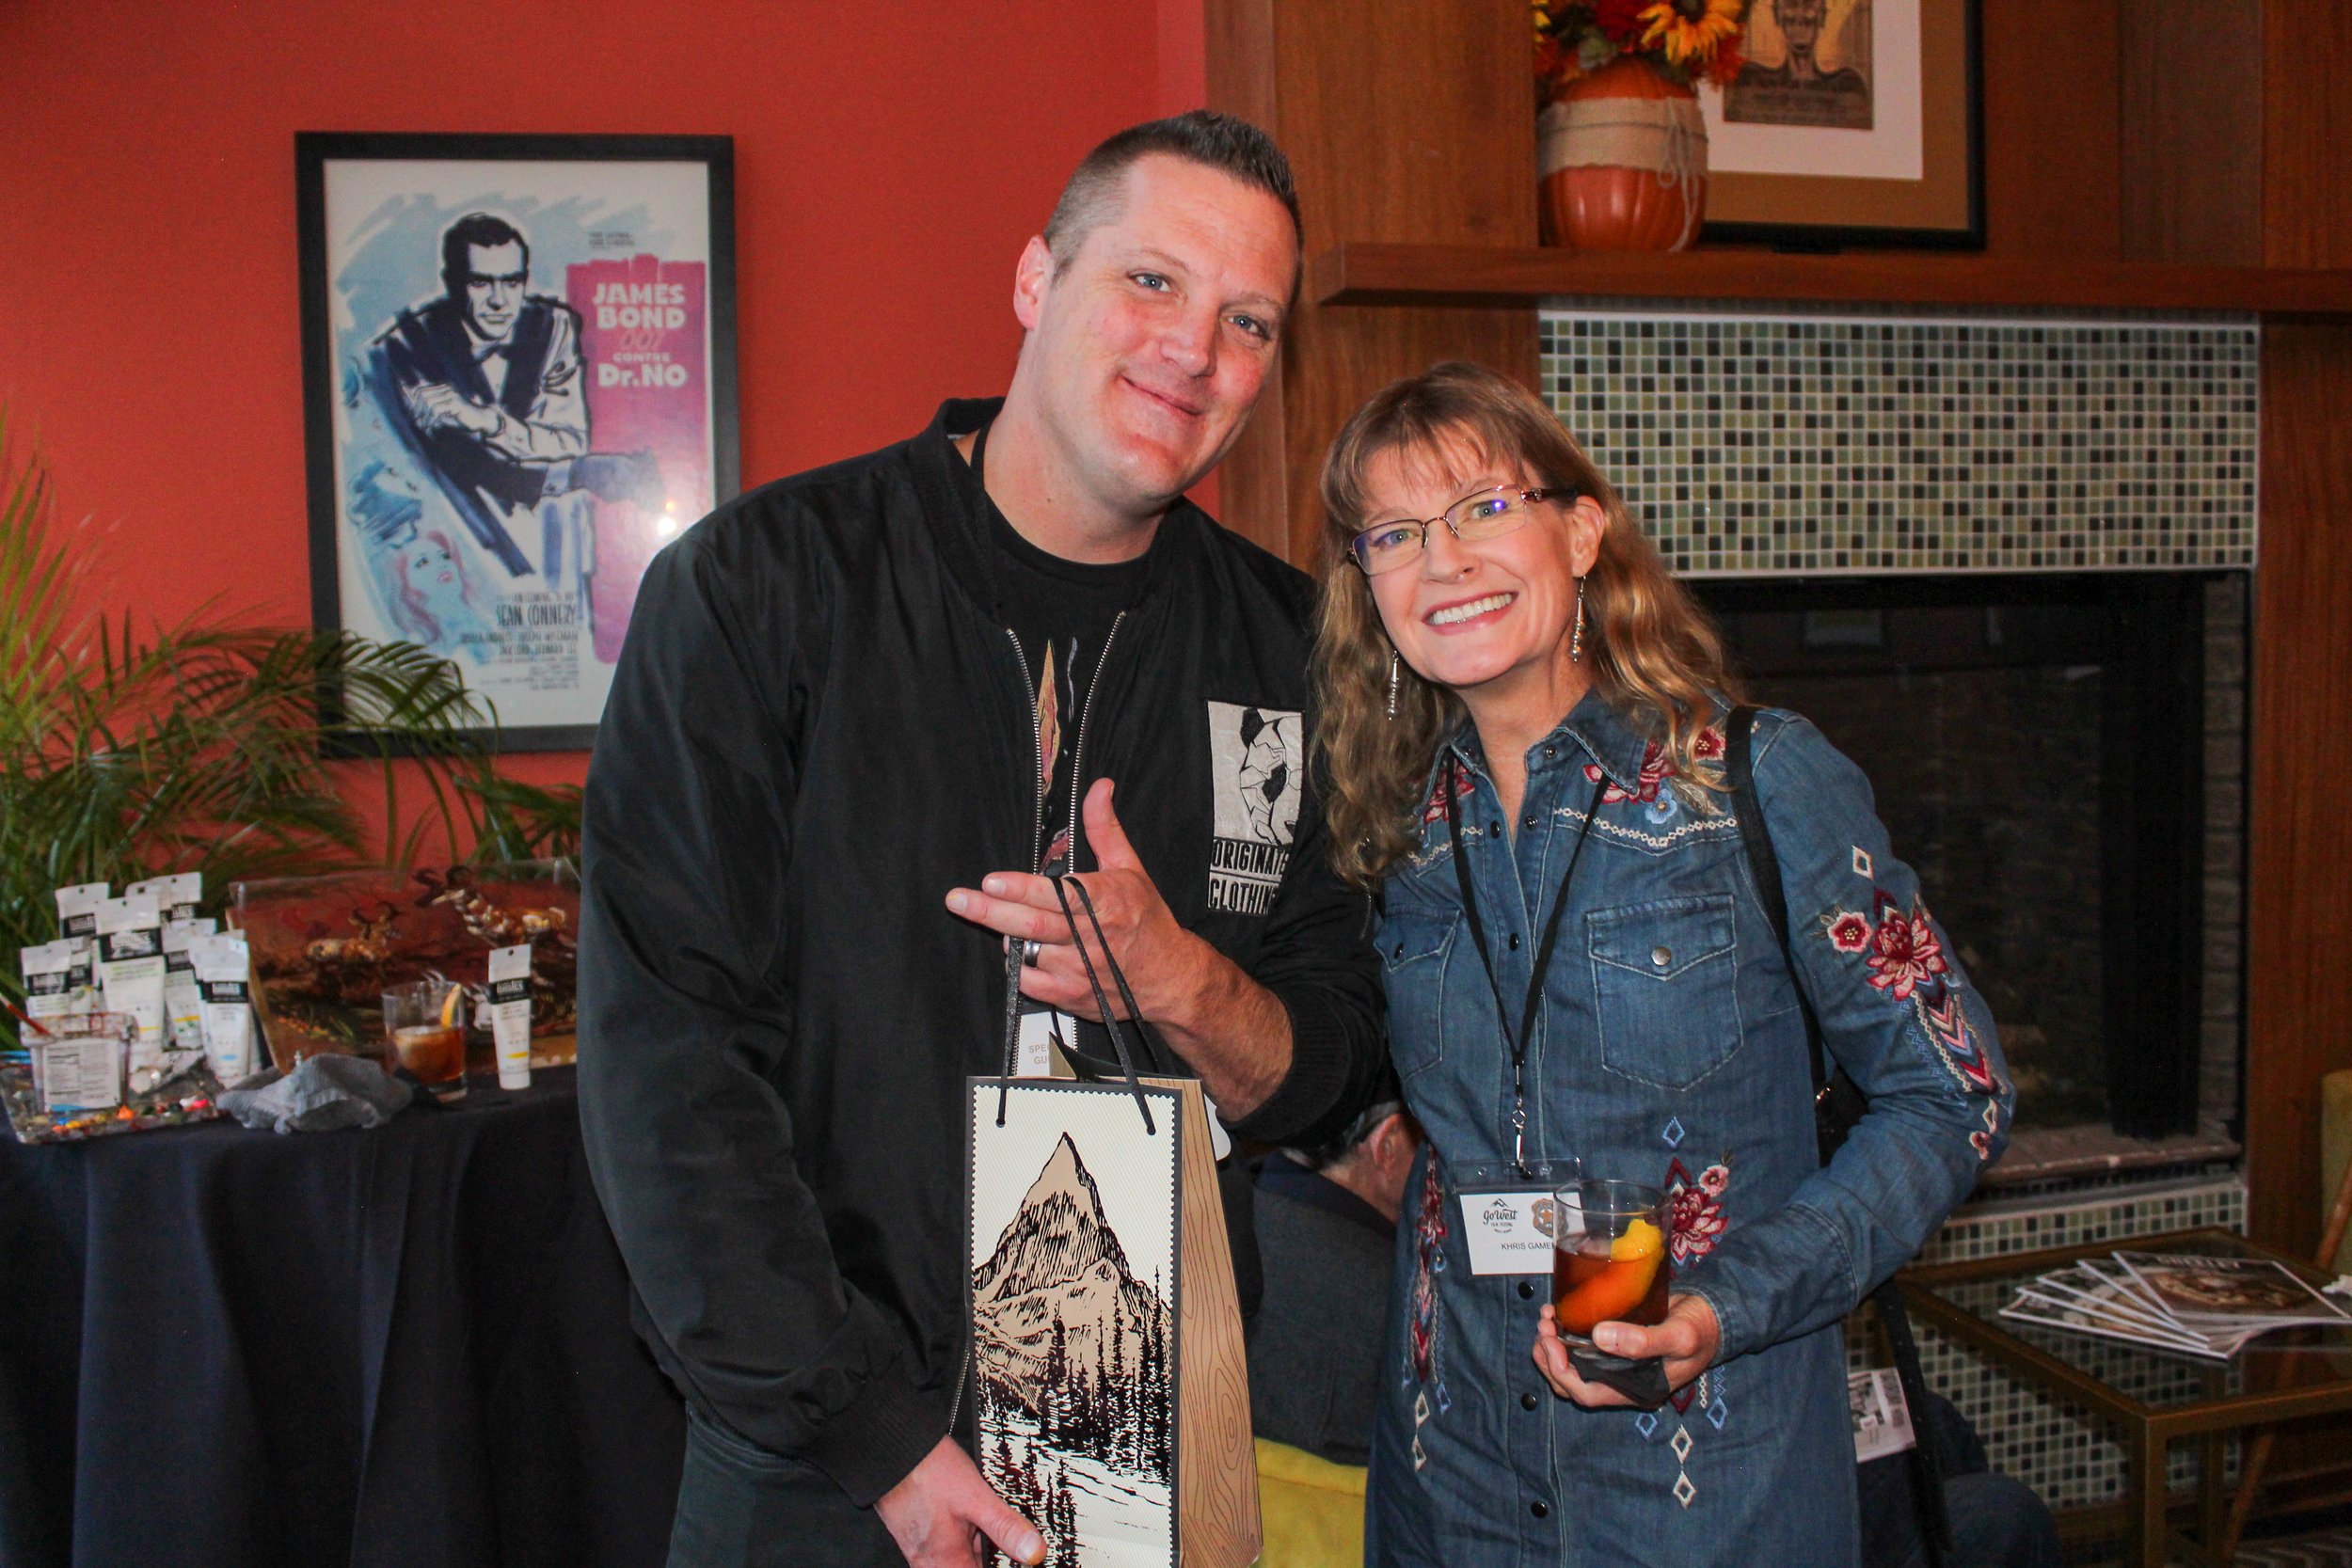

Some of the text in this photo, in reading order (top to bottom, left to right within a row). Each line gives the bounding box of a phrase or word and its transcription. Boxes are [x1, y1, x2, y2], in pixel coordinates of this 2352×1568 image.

[593, 283, 685, 306] JAMES
[596, 306, 686, 329] BOND
[597, 363, 688, 388] Dr.NO
[496, 604, 576, 626] SEAN CONNERY
[1028, 1044, 1050, 1053] SPE
[1501, 1242, 1554, 1250] KHRIS GAME
